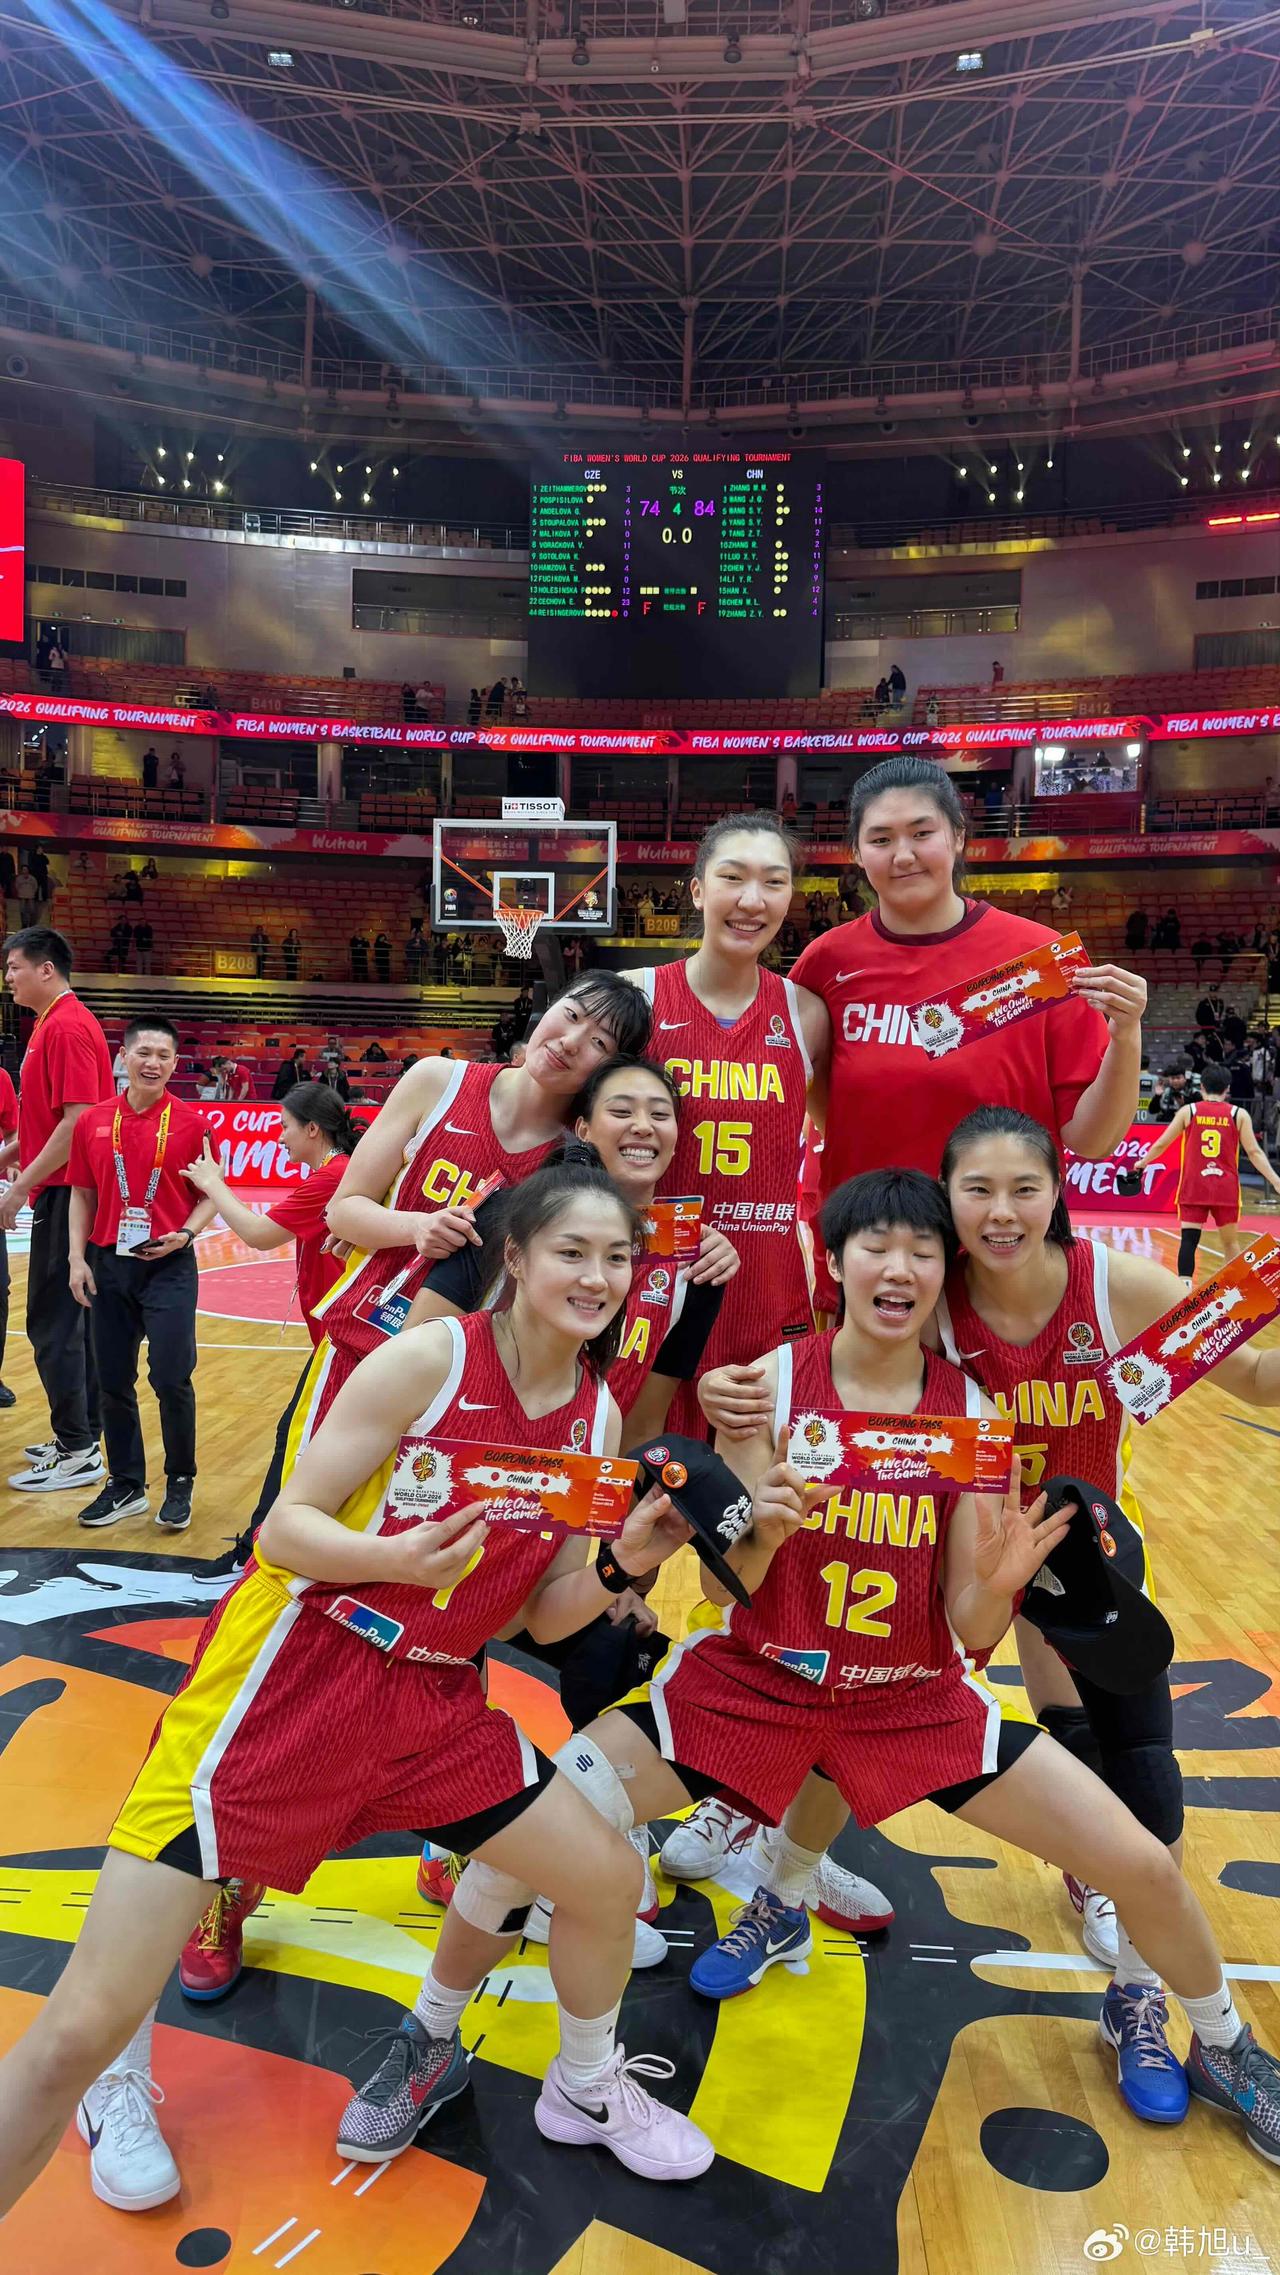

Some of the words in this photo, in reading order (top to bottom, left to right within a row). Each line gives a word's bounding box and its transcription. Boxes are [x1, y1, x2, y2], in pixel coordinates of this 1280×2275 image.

[563, 454, 583, 462] FIBA
[587, 454, 620, 462] WOMEN'S
[624, 454, 648, 462] WORLD
[651, 454, 666, 462] CUP
[670, 454, 689, 462] 2026
[693, 454, 740, 462] QUALIFYING
[745, 453, 791, 461] TOURNAMENT
[584, 470, 601, 479] CZE
[671, 470, 683, 479] VS
[746, 469, 764, 479] CHN
[640, 500, 661, 516] 74
[673, 502, 682, 515] 4
[694, 500, 716, 516] 84
[662, 527, 692, 544] 0.0
[643, 602, 652, 615] F
[698, 602, 706, 615] F
[0, 700, 31, 713] 2026
[36, 703, 109, 720] QUALIFYING
[113, 709, 198, 727] TOURNAMENT
[1080, 702, 1111, 715] B412
[1166, 718, 1199, 733] FIBA
[1202, 713, 1270, 731] WOMEN'S
[236, 719, 265, 732] FIBA
[268, 721, 328, 736] WOMEN'S
[331, 724, 402, 741] BASKETBALL
[406, 729, 447, 743] WORLD
[450, 731, 477, 743] CUP
[478, 733, 506, 745] 2026
[510, 733, 576, 746] QUALIFYING
[579, 735, 657, 748] TOURNAMENT
[692, 736, 719, 749] FIBA
[723, 736, 780, 749] WOMEN'S
[783, 734, 854, 749] BASKETBALL
[857, 732, 899, 747] WORLD
[902, 731, 930, 745] CUP
[931, 731, 962, 744] 2026
[965, 727, 1037, 743] QUALIFYING
[1041, 722, 1127, 739] TOURNAMENT
[312, 834, 367, 850] Wuhan
[638, 844, 690, 860] Wuhan
[647, 919, 678, 931] B209
[218, 955, 255, 970] B208
[966, 970, 1004, 992] BOARDING
[1005, 961, 1024, 975] PASS
[992, 983, 1012, 997] CHINA
[842, 1003, 922, 1047] CHIN
[664, 1057, 785, 1103] CHINA
[233, 1111, 282, 1133] CUP
[1196, 1116, 1216, 1126] WANG
[693, 1121, 753, 1176] 15
[1110, 1141, 1151, 1159] 026
[1201, 1129, 1221, 1158] 3
[712, 1202, 796, 1221] 中国银联
[709, 1220, 740, 1231] China
[742, 1221, 791, 1236] UnionPay
[1160, 1297, 1200, 1333] BOARDING
[1199, 1282, 1220, 1300] PASS
[1191, 1310, 1213, 1330] CHINA
[868, 1416, 916, 1429] BOARDING
[919, 1419, 943, 1430] PASS
[892, 1437, 917, 1446] CHINA
[484, 1450, 537, 1465] BOARDING
[538, 1456, 564, 1468] PASS
[507, 1474, 534, 1484] CHINA
[820, 1560, 897, 1638] 12
[329, 1609, 389, 1648] UnionPay
